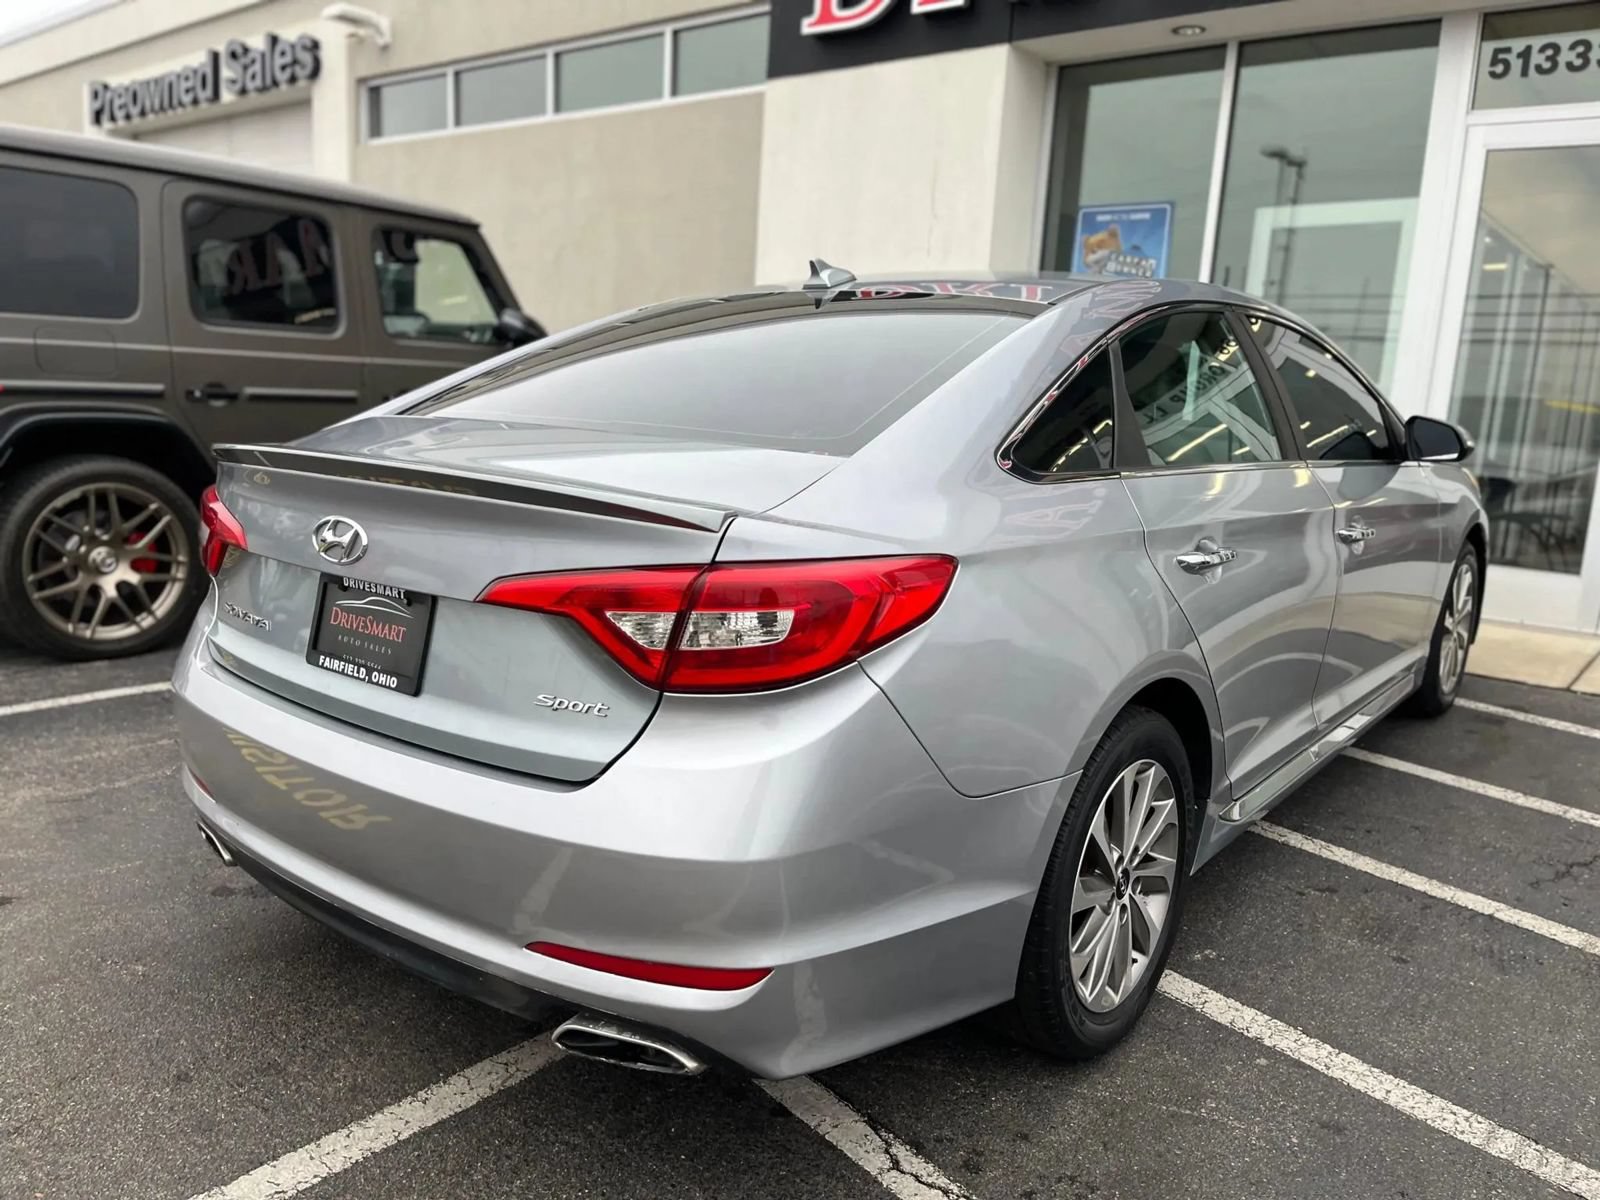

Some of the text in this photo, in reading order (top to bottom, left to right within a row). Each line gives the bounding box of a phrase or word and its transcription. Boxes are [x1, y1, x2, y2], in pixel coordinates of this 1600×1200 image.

[1488, 38, 1600, 80] 5133
[90, 32, 321, 126] Preowned Sales
[343, 577, 406, 599] DRIVESMART
[319, 655, 368, 682] FAIRFIELD,
[371, 671, 398, 688] OHIO
[533, 694, 609, 717] Sport
